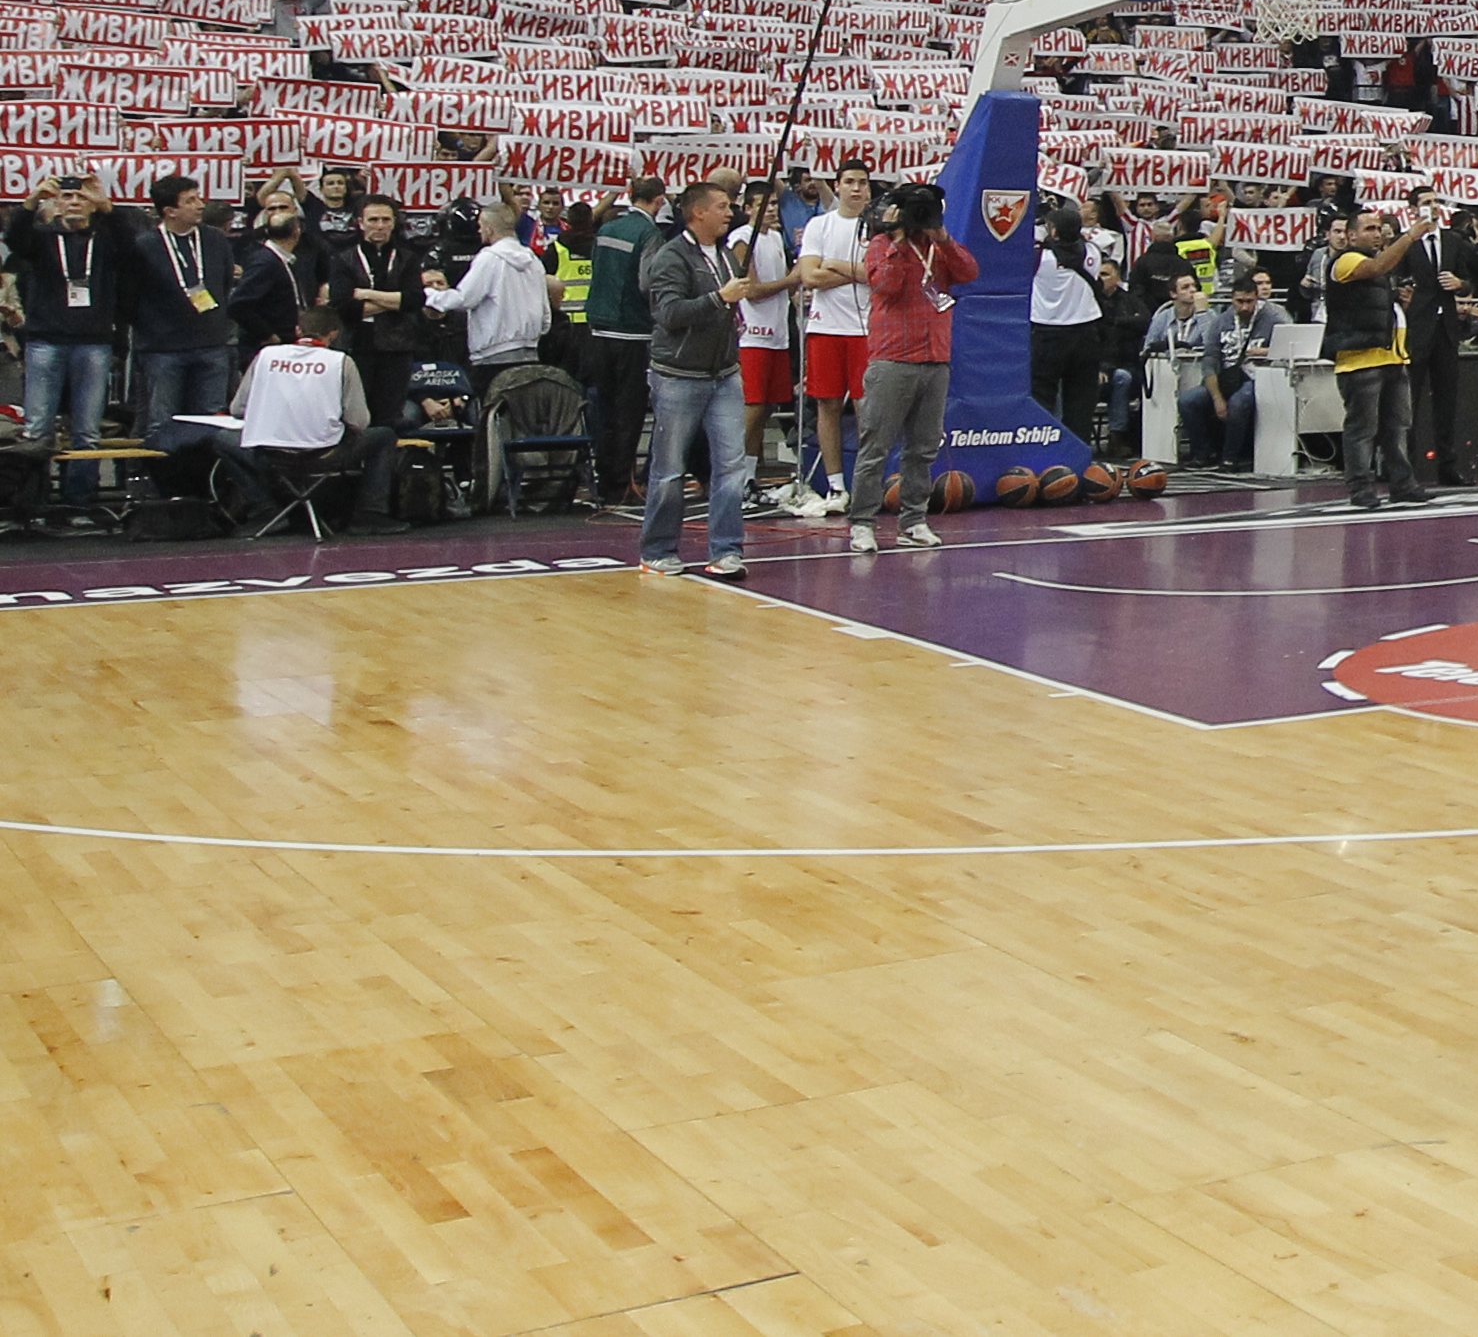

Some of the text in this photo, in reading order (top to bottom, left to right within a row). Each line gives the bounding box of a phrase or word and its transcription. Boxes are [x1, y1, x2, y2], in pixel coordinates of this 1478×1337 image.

[61, 11, 169, 46] ЖИВИШ
[501, 44, 594, 70] ЖИВИШ
[1217, 45, 1279, 67] ЖИВИШ
[61, 69, 189, 112] ЖИВИШ
[882, 73, 969, 101] ЖИВИШ
[1213, 84, 1285, 113] ЖИВИШ
[386, 95, 510, 132] ЖИВИШ
[518, 108, 631, 142] ЖИВИШ
[607, 96, 707, 128] ЖИВИШ
[161, 122, 300, 163] ЖИВИШ
[503, 139, 630, 187] ЖИВИШ
[1107, 151, 1207, 187] ЖИВИШ
[1216, 144, 1309, 183] ЖИВИШ
[375, 166, 498, 207] ЖИВИШ
[269, 359, 327, 376] PHOTO
[424, 376, 458, 388] ARENA
[950, 426, 1060, 447] Telekom Srbija
